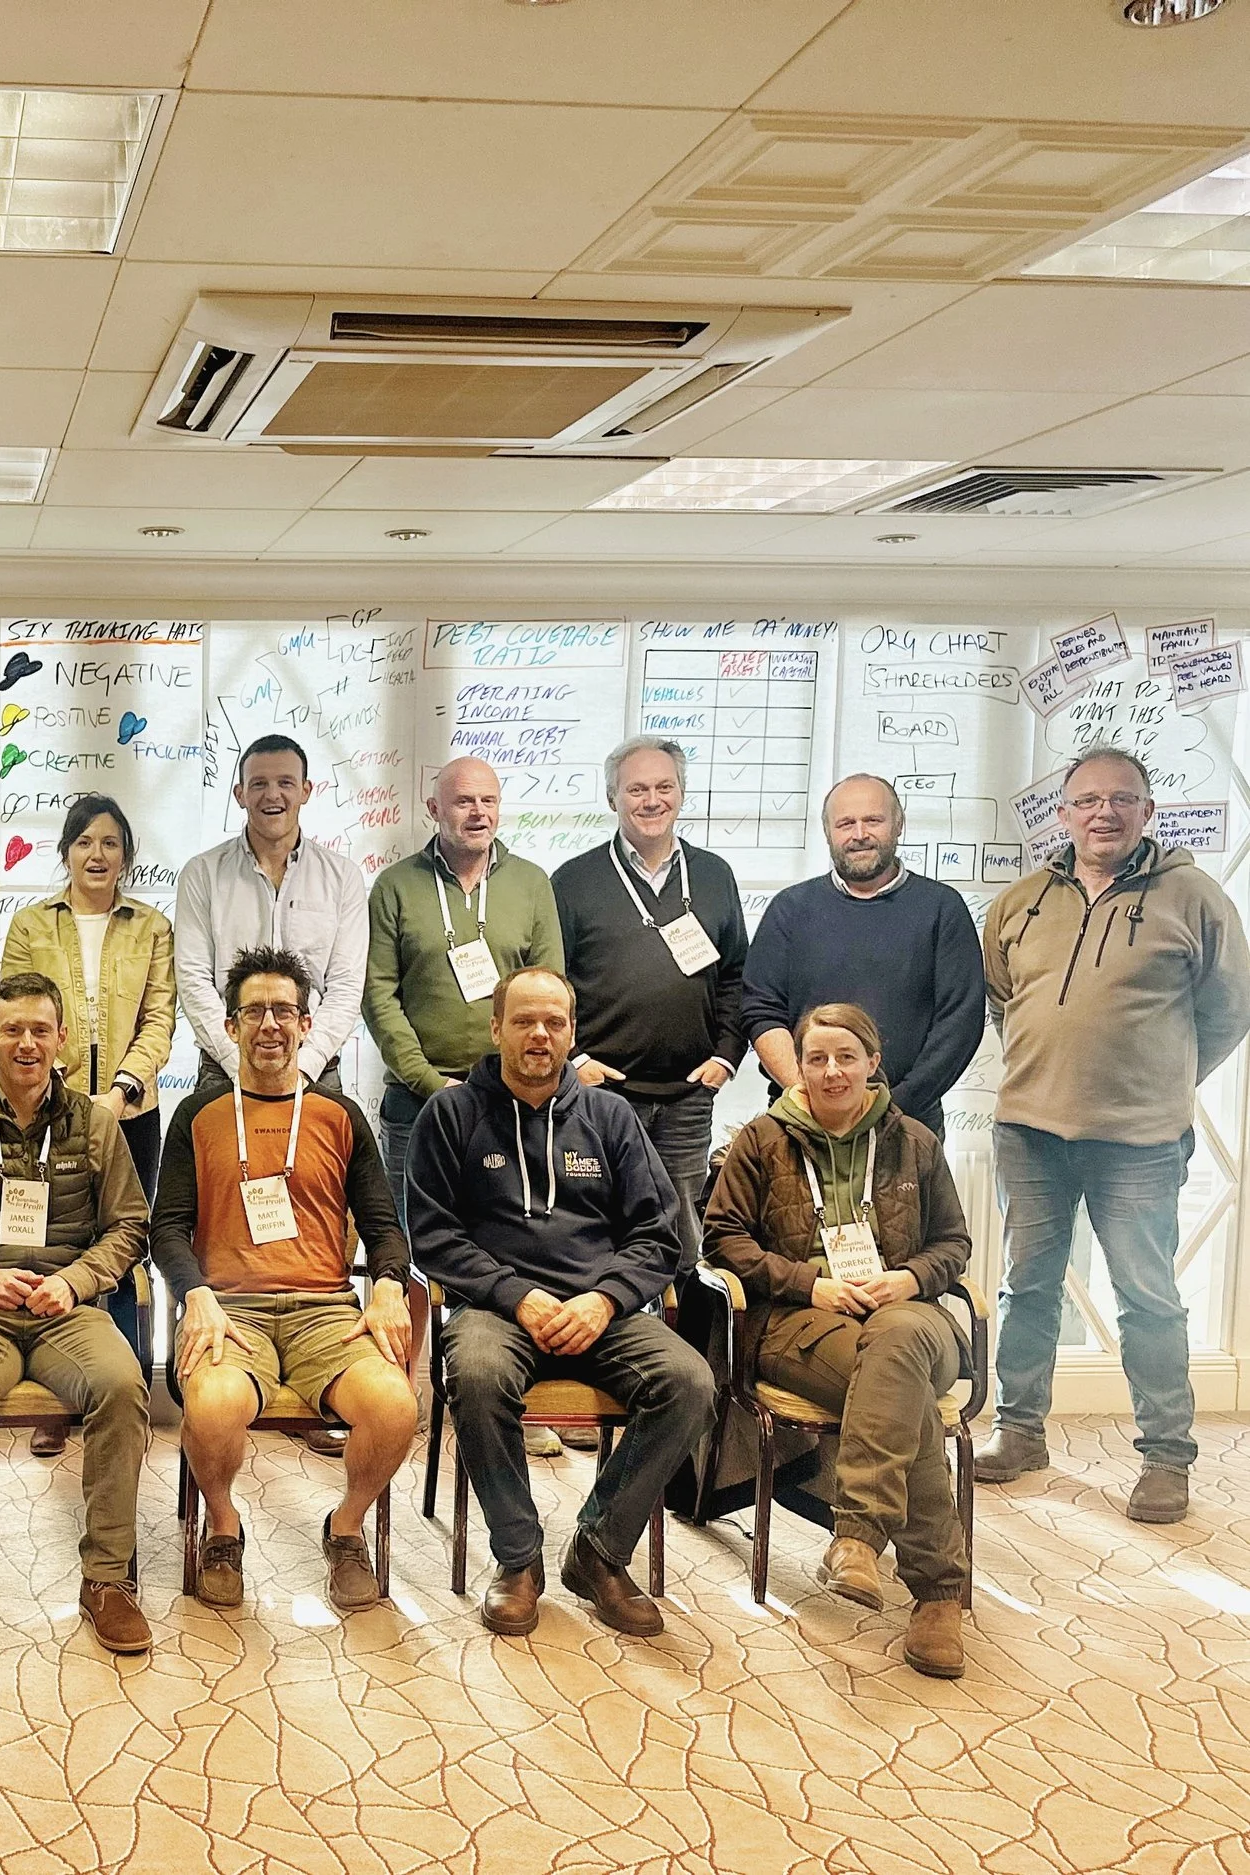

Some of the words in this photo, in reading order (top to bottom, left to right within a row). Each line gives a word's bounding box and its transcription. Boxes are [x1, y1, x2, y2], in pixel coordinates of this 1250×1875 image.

[352, 607, 382, 629] GP
[8, 620, 52, 640] SIX
[64, 621, 158, 640] THINKING
[167, 622, 206, 642] HATS
[433, 621, 499, 648] DEBT
[506, 622, 619, 646] COVERAGE
[639, 620, 696, 642] SHOW
[704, 620, 736, 638] ME
[1088, 633, 1107, 648] AND
[1152, 624, 1208, 641] MAINTAINS
[860, 625, 916, 660] ORG
[929, 631, 1008, 656] CHART
[1160, 637, 1199, 652] FAMILY
[473, 645, 557, 667] RATIO
[720, 651, 768, 666] FIXED
[772, 652, 815, 665] WORKING
[56, 661, 192, 696] NEGATIVE
[721, 664, 761, 677] ASSETS
[772, 666, 814, 678] CAPITAL
[1028, 664, 1061, 690] ENJOYE
[1177, 671, 1197, 683] FEEL
[457, 682, 578, 702] OPERATING
[1087, 680, 1125, 699] HAT
[1134, 680, 1162, 700] DO
[1177, 683, 1194, 694] AND
[1200, 674, 1231, 689] HEARD
[643, 685, 704, 704] VEHICLES
[1043, 689, 1064, 705] ALL
[34, 707, 111, 729] POSITIVE
[456, 703, 535, 721] INCOME
[1069, 704, 1114, 722] WANT
[1128, 704, 1167, 725] THIS
[643, 714, 705, 730] TRACTORS
[881, 716, 949, 737] BOARD
[451, 729, 510, 747] ANNUAL
[519, 726, 574, 747] DEBT
[1072, 723, 1123, 745] PLACE
[1135, 728, 1159, 746] TO
[203, 709, 220, 788] PROFIT
[469, 749, 561, 765] PAYMENTS
[28, 750, 116, 772] CREATIVE
[903, 778, 936, 790] CEO
[36, 792, 100, 811] FAC
[1022, 788, 1062, 818] FINANCI
[359, 804, 401, 830] PEOPLE
[518, 811, 562, 829] BUY
[573, 812, 607, 828] THE
[1025, 804, 1057, 830] REWA
[1157, 808, 1223, 820] TRANSPARENT
[1159, 820, 1180, 829] AND
[942, 853, 962, 866] HR
[131, 864, 179, 888] DEBON
[564, 1152, 578, 1160] MY
[10, 1214, 35, 1223] JAMES
[258, 1210, 279, 1220] MATT
[7, 1225, 35, 1234] YOXALL
[256, 1220, 286, 1231] GRIFFIN
[832, 1257, 874, 1269] FLORENCE
